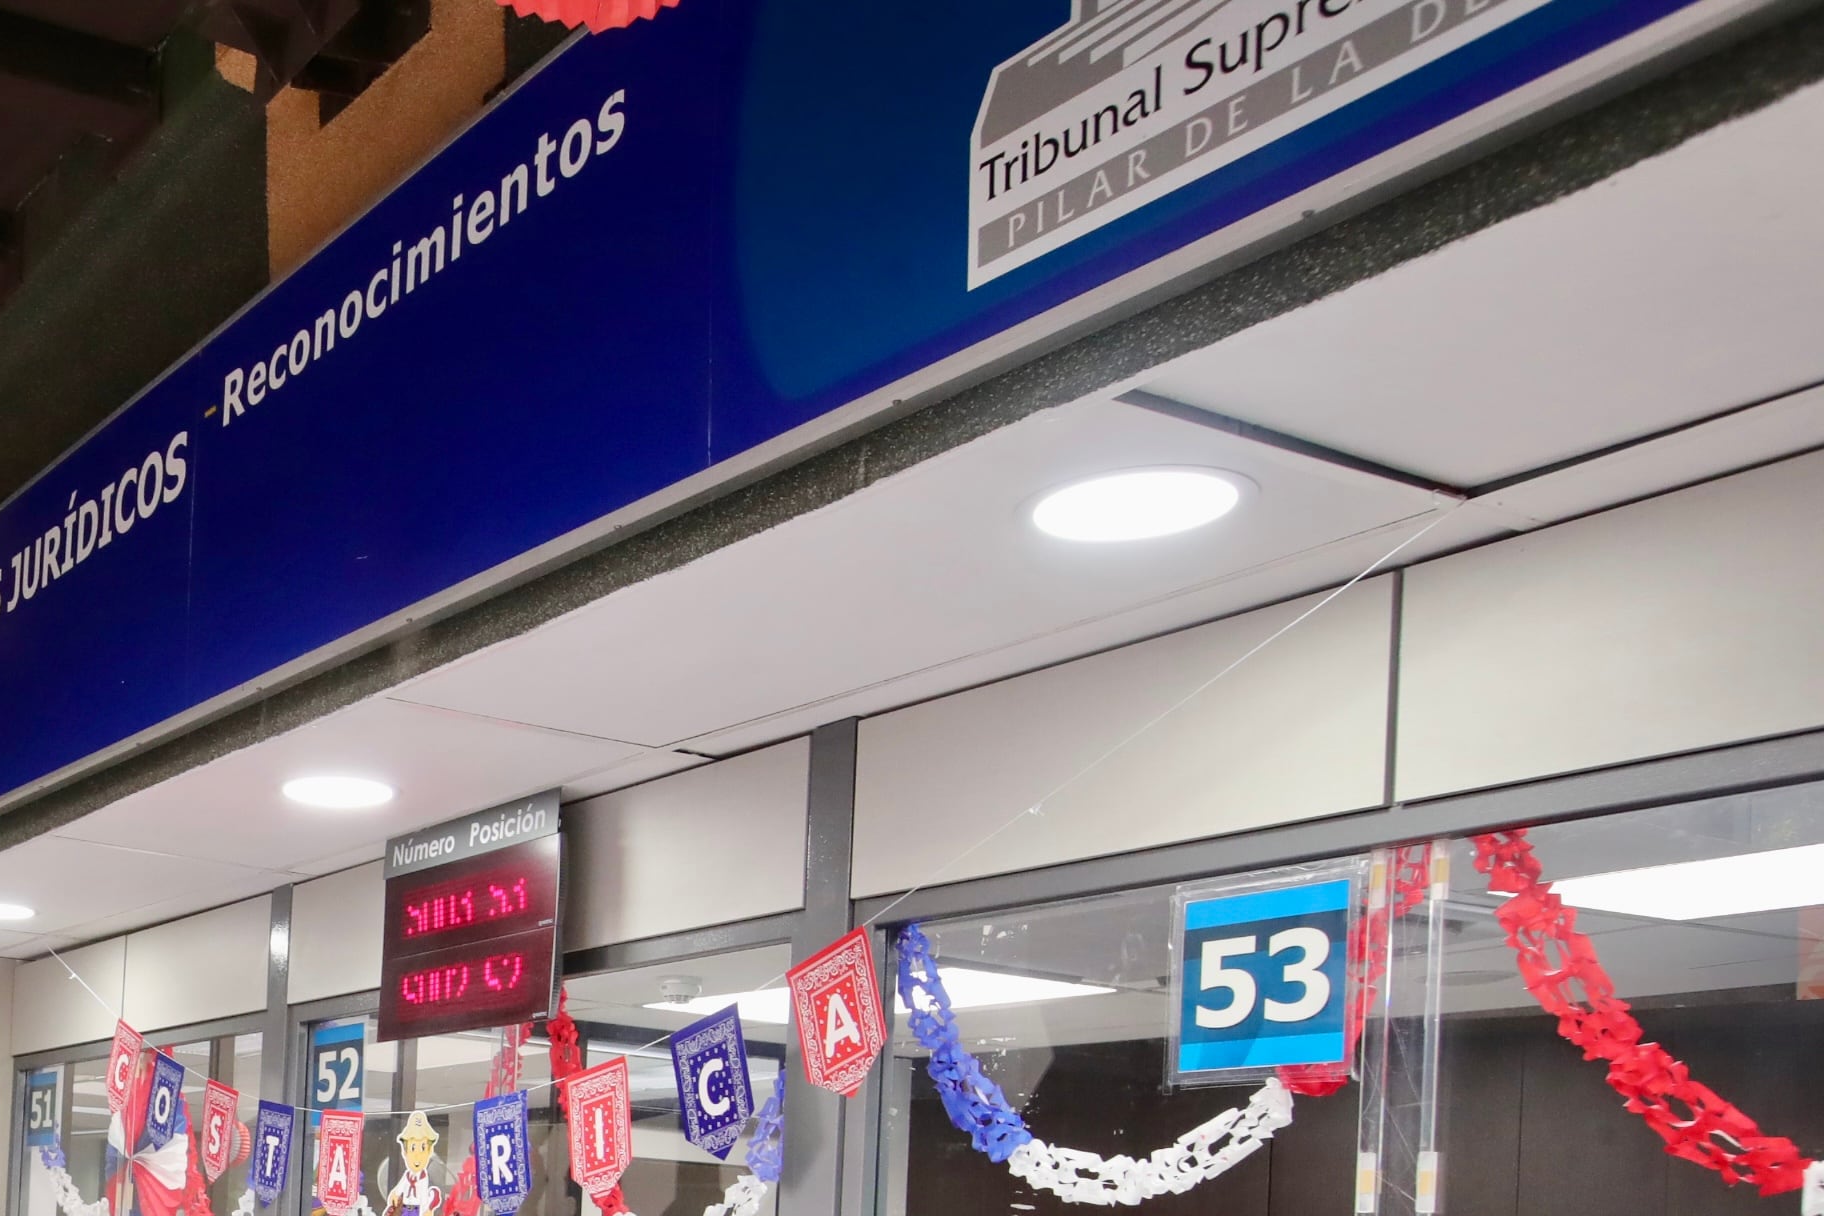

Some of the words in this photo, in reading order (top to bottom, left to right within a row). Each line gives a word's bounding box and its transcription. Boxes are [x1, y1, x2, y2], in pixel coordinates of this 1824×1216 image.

[979, 64, 1162, 201] Tribunal
[1007, 149, 1151, 248] PILAR
[1184, 95, 1249, 158] DE
[1290, 40, 1364, 105] LA
[7, 431, 188, 613] JURÍDICOS
[392, 836, 456, 868] Número
[469, 803, 546, 847] Posición
[1195, 927, 1330, 1029] 53
[30, 1089, 53, 1129] 51
[316, 1047, 360, 1102] 52
